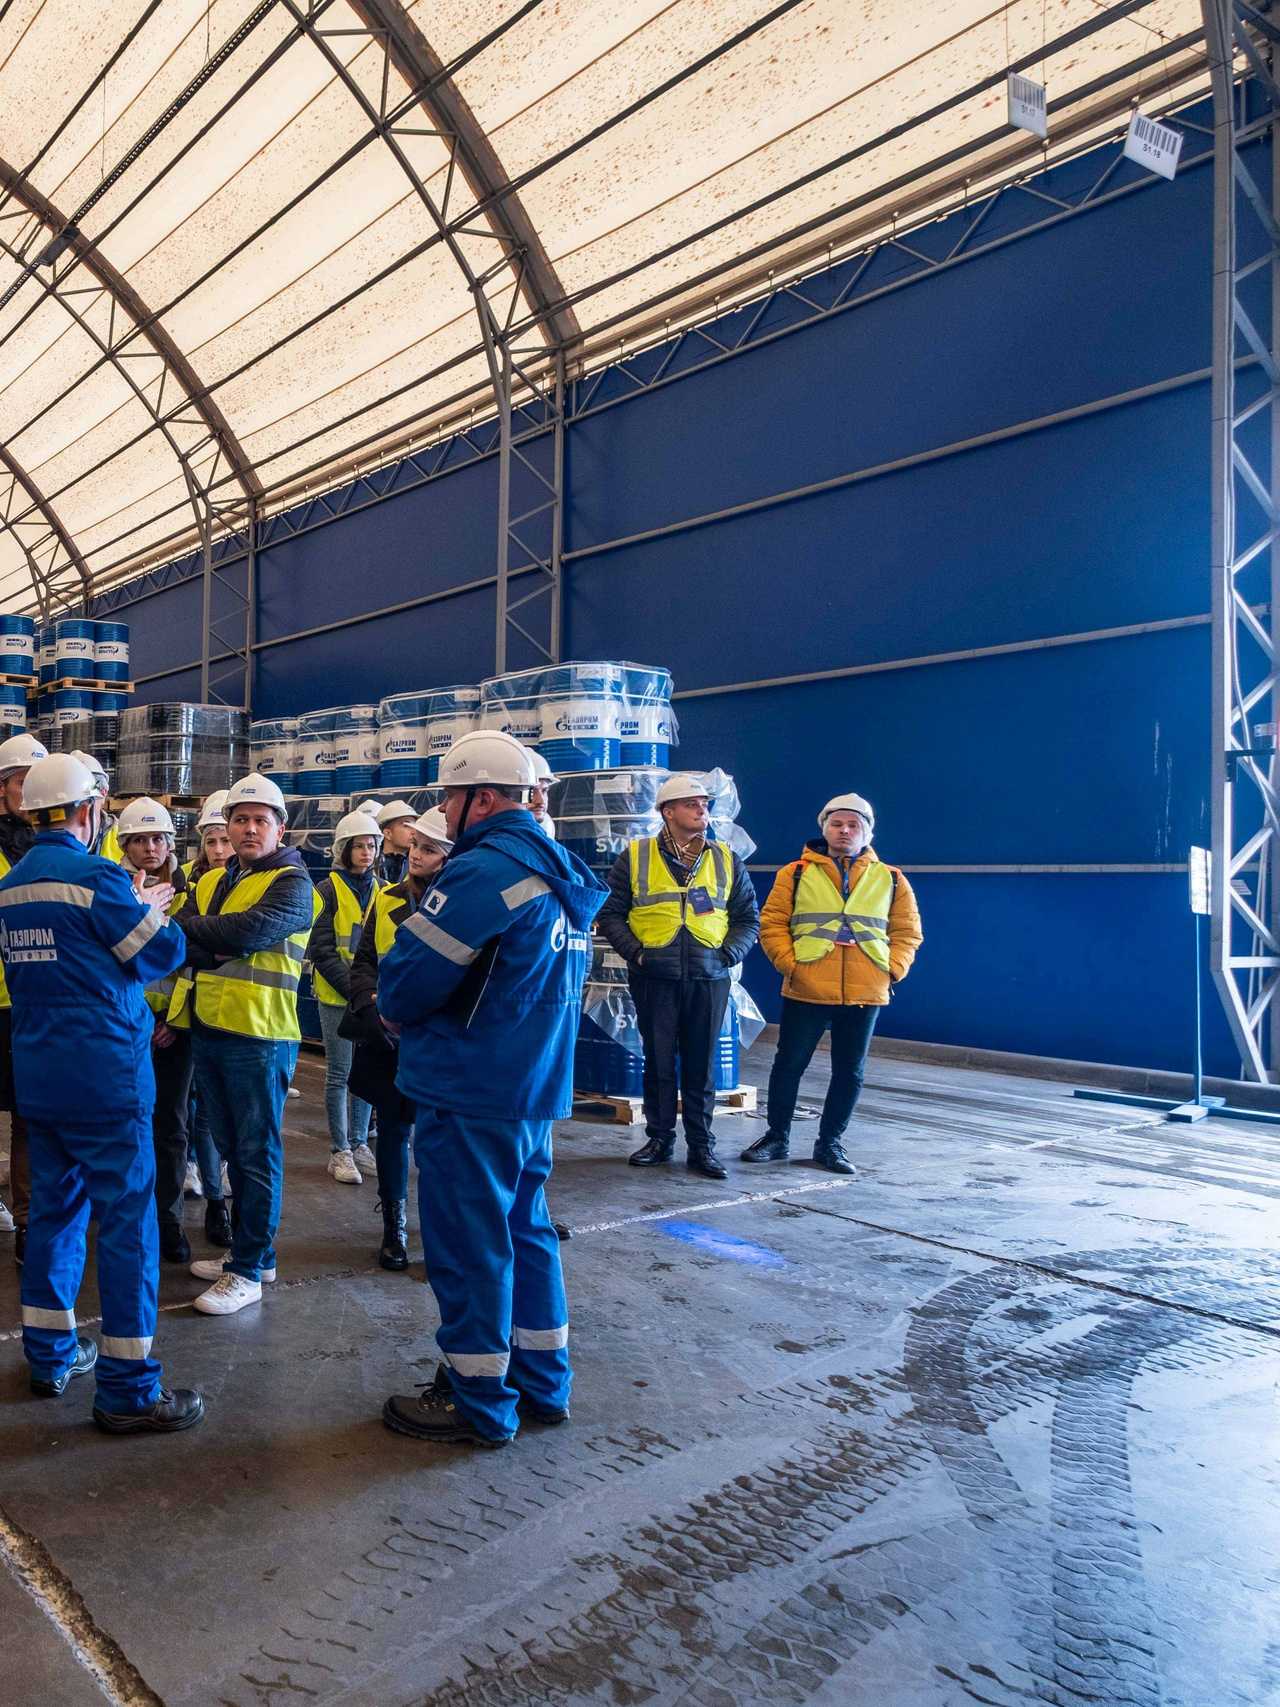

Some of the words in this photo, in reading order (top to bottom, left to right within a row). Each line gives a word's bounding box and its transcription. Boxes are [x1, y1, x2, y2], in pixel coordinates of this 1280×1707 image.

[1021, 104, 1035, 118] S1.17
[1142, 143, 1161, 159] S1.18
[621, 721, 639, 729] PROM
[392, 740, 416, 748] GAZPROM
[596, 836, 630, 853] SYN
[10, 928, 55, 948] ГАЗПРОМ
[11, 950, 56, 962] НЕФТЬ
